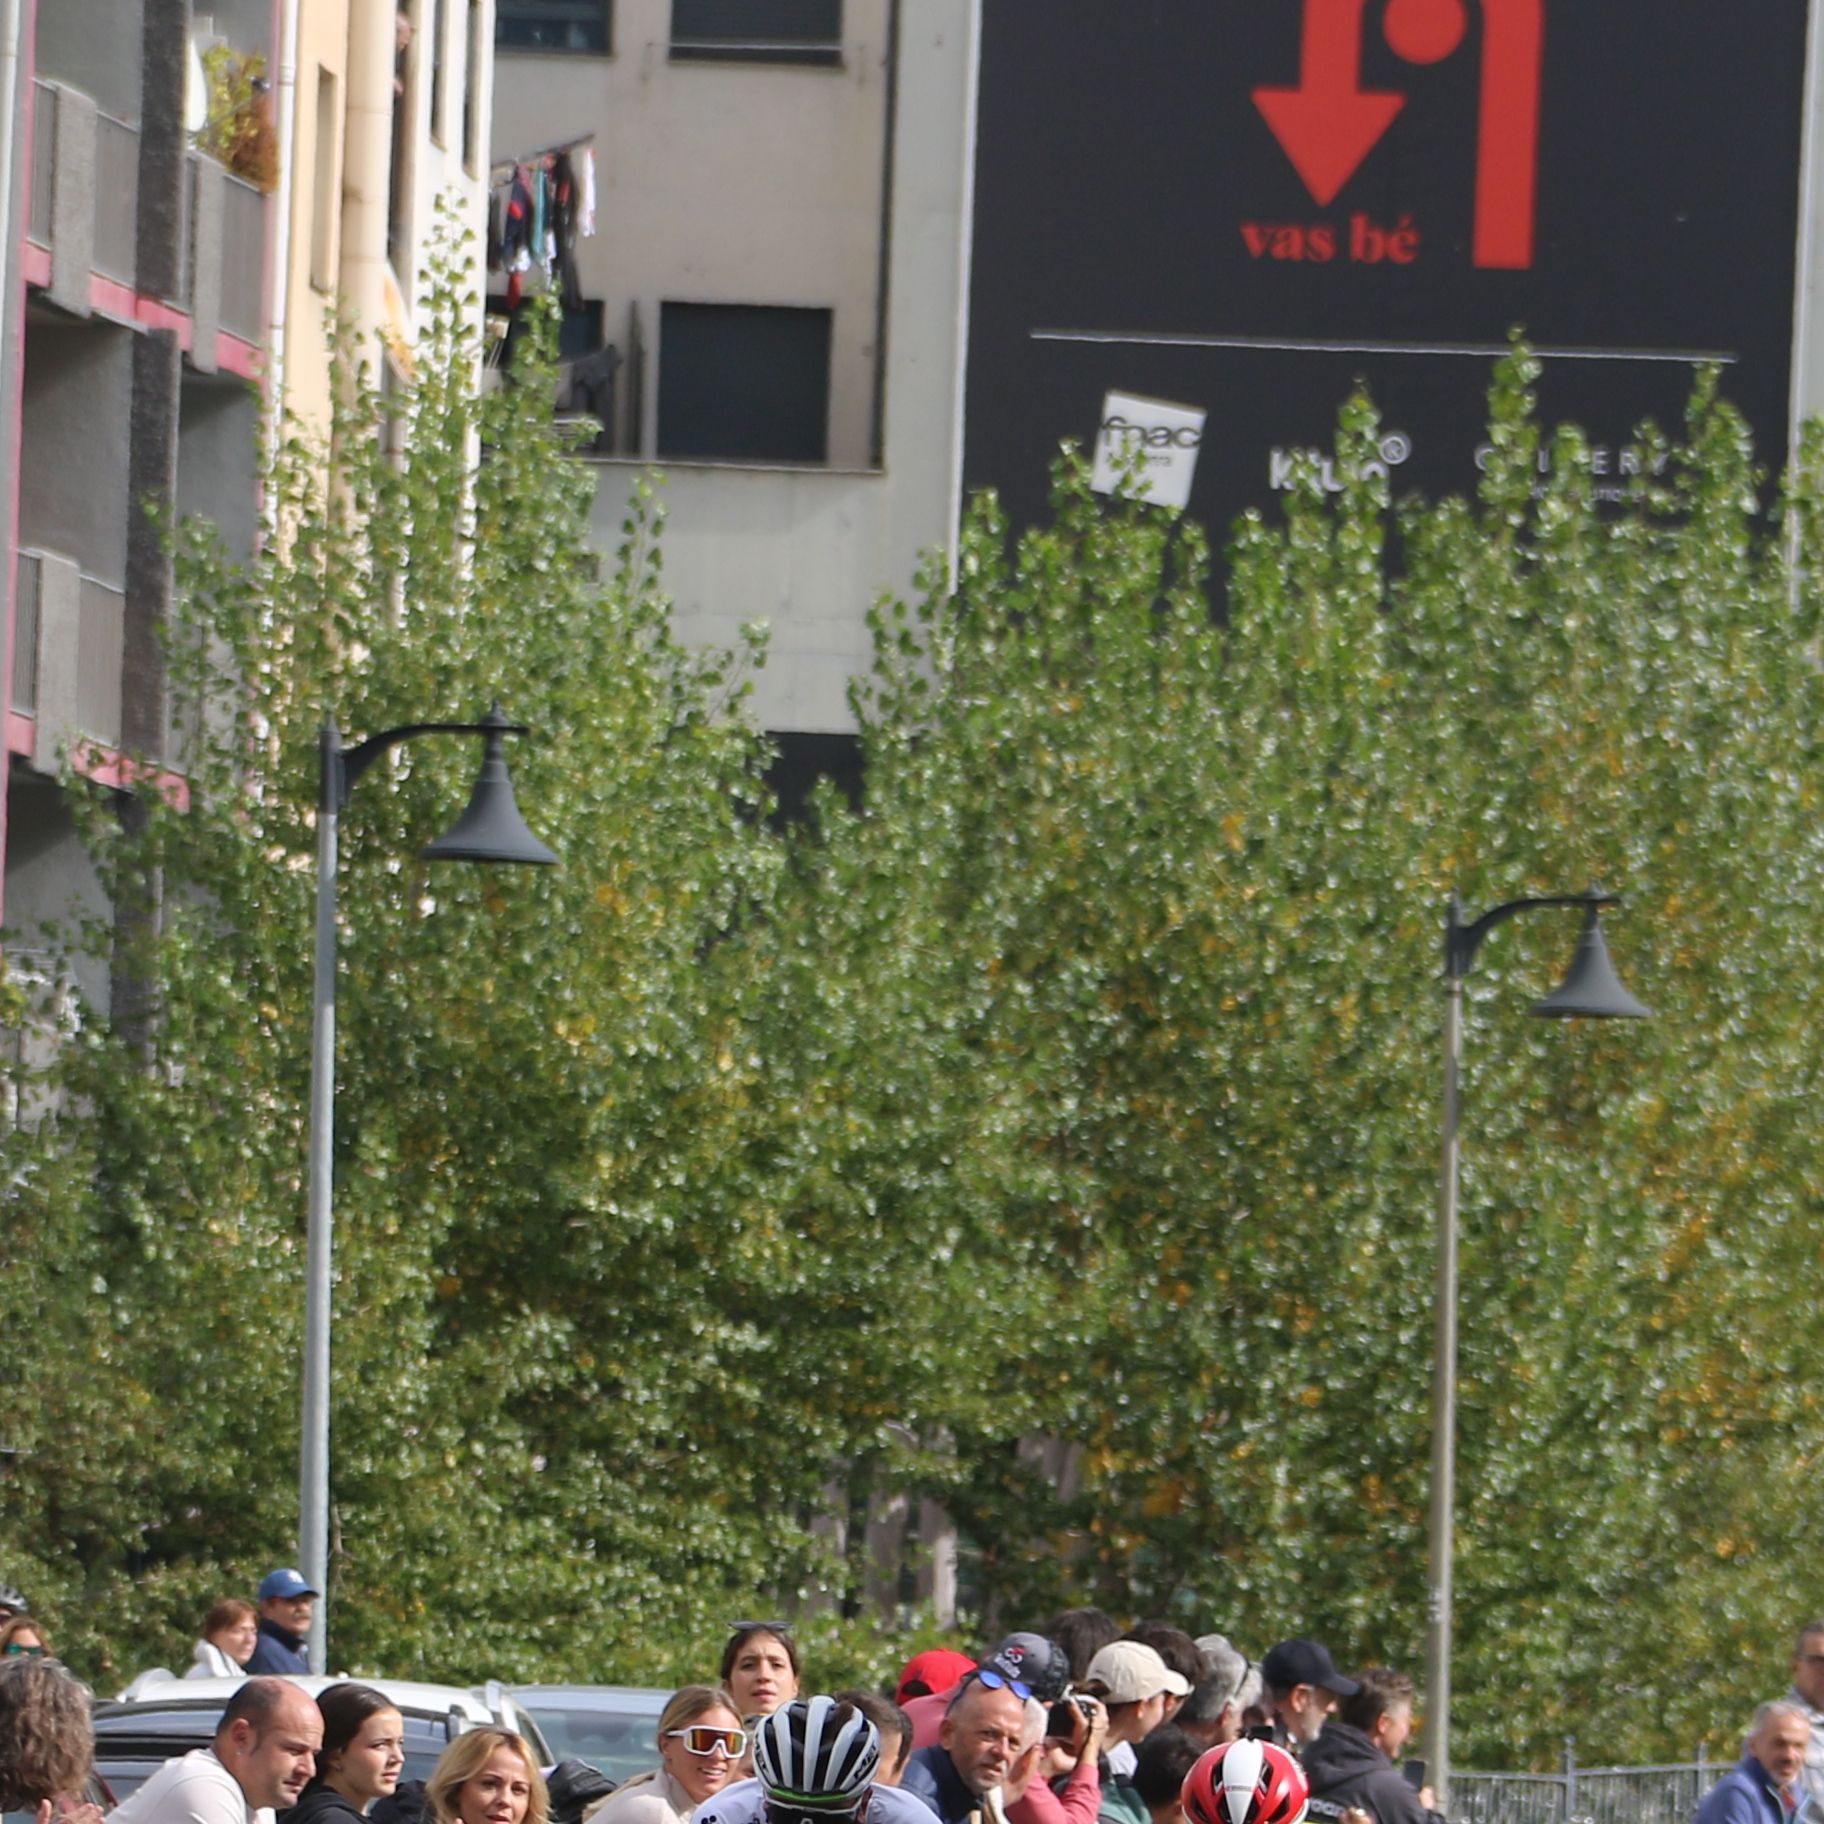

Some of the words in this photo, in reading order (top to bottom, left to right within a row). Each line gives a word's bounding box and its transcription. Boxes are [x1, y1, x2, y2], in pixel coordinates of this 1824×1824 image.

[1239, 222, 1336, 262] vas
[1350, 210, 1419, 265] bé
[1101, 416, 1201, 450] fnac
